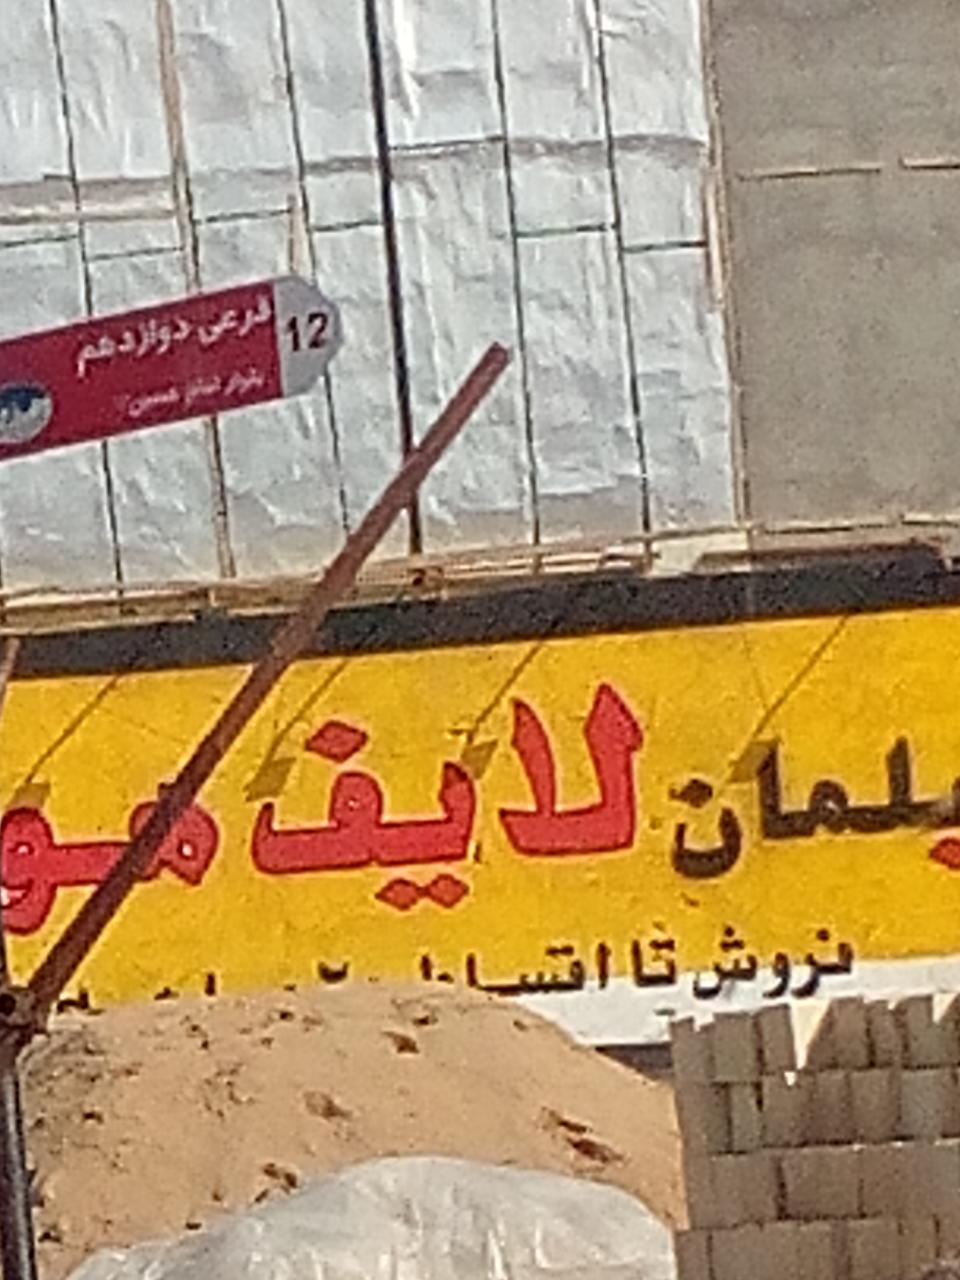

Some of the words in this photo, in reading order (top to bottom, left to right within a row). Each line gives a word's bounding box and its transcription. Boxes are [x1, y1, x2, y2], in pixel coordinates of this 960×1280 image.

[77, 316, 190, 378] دوازدهم
[198, 295, 272, 345] فرعی
[286, 312, 328, 352] 12
[251, 682, 644, 911] لایف
[693, 926, 854, 999] فروش
